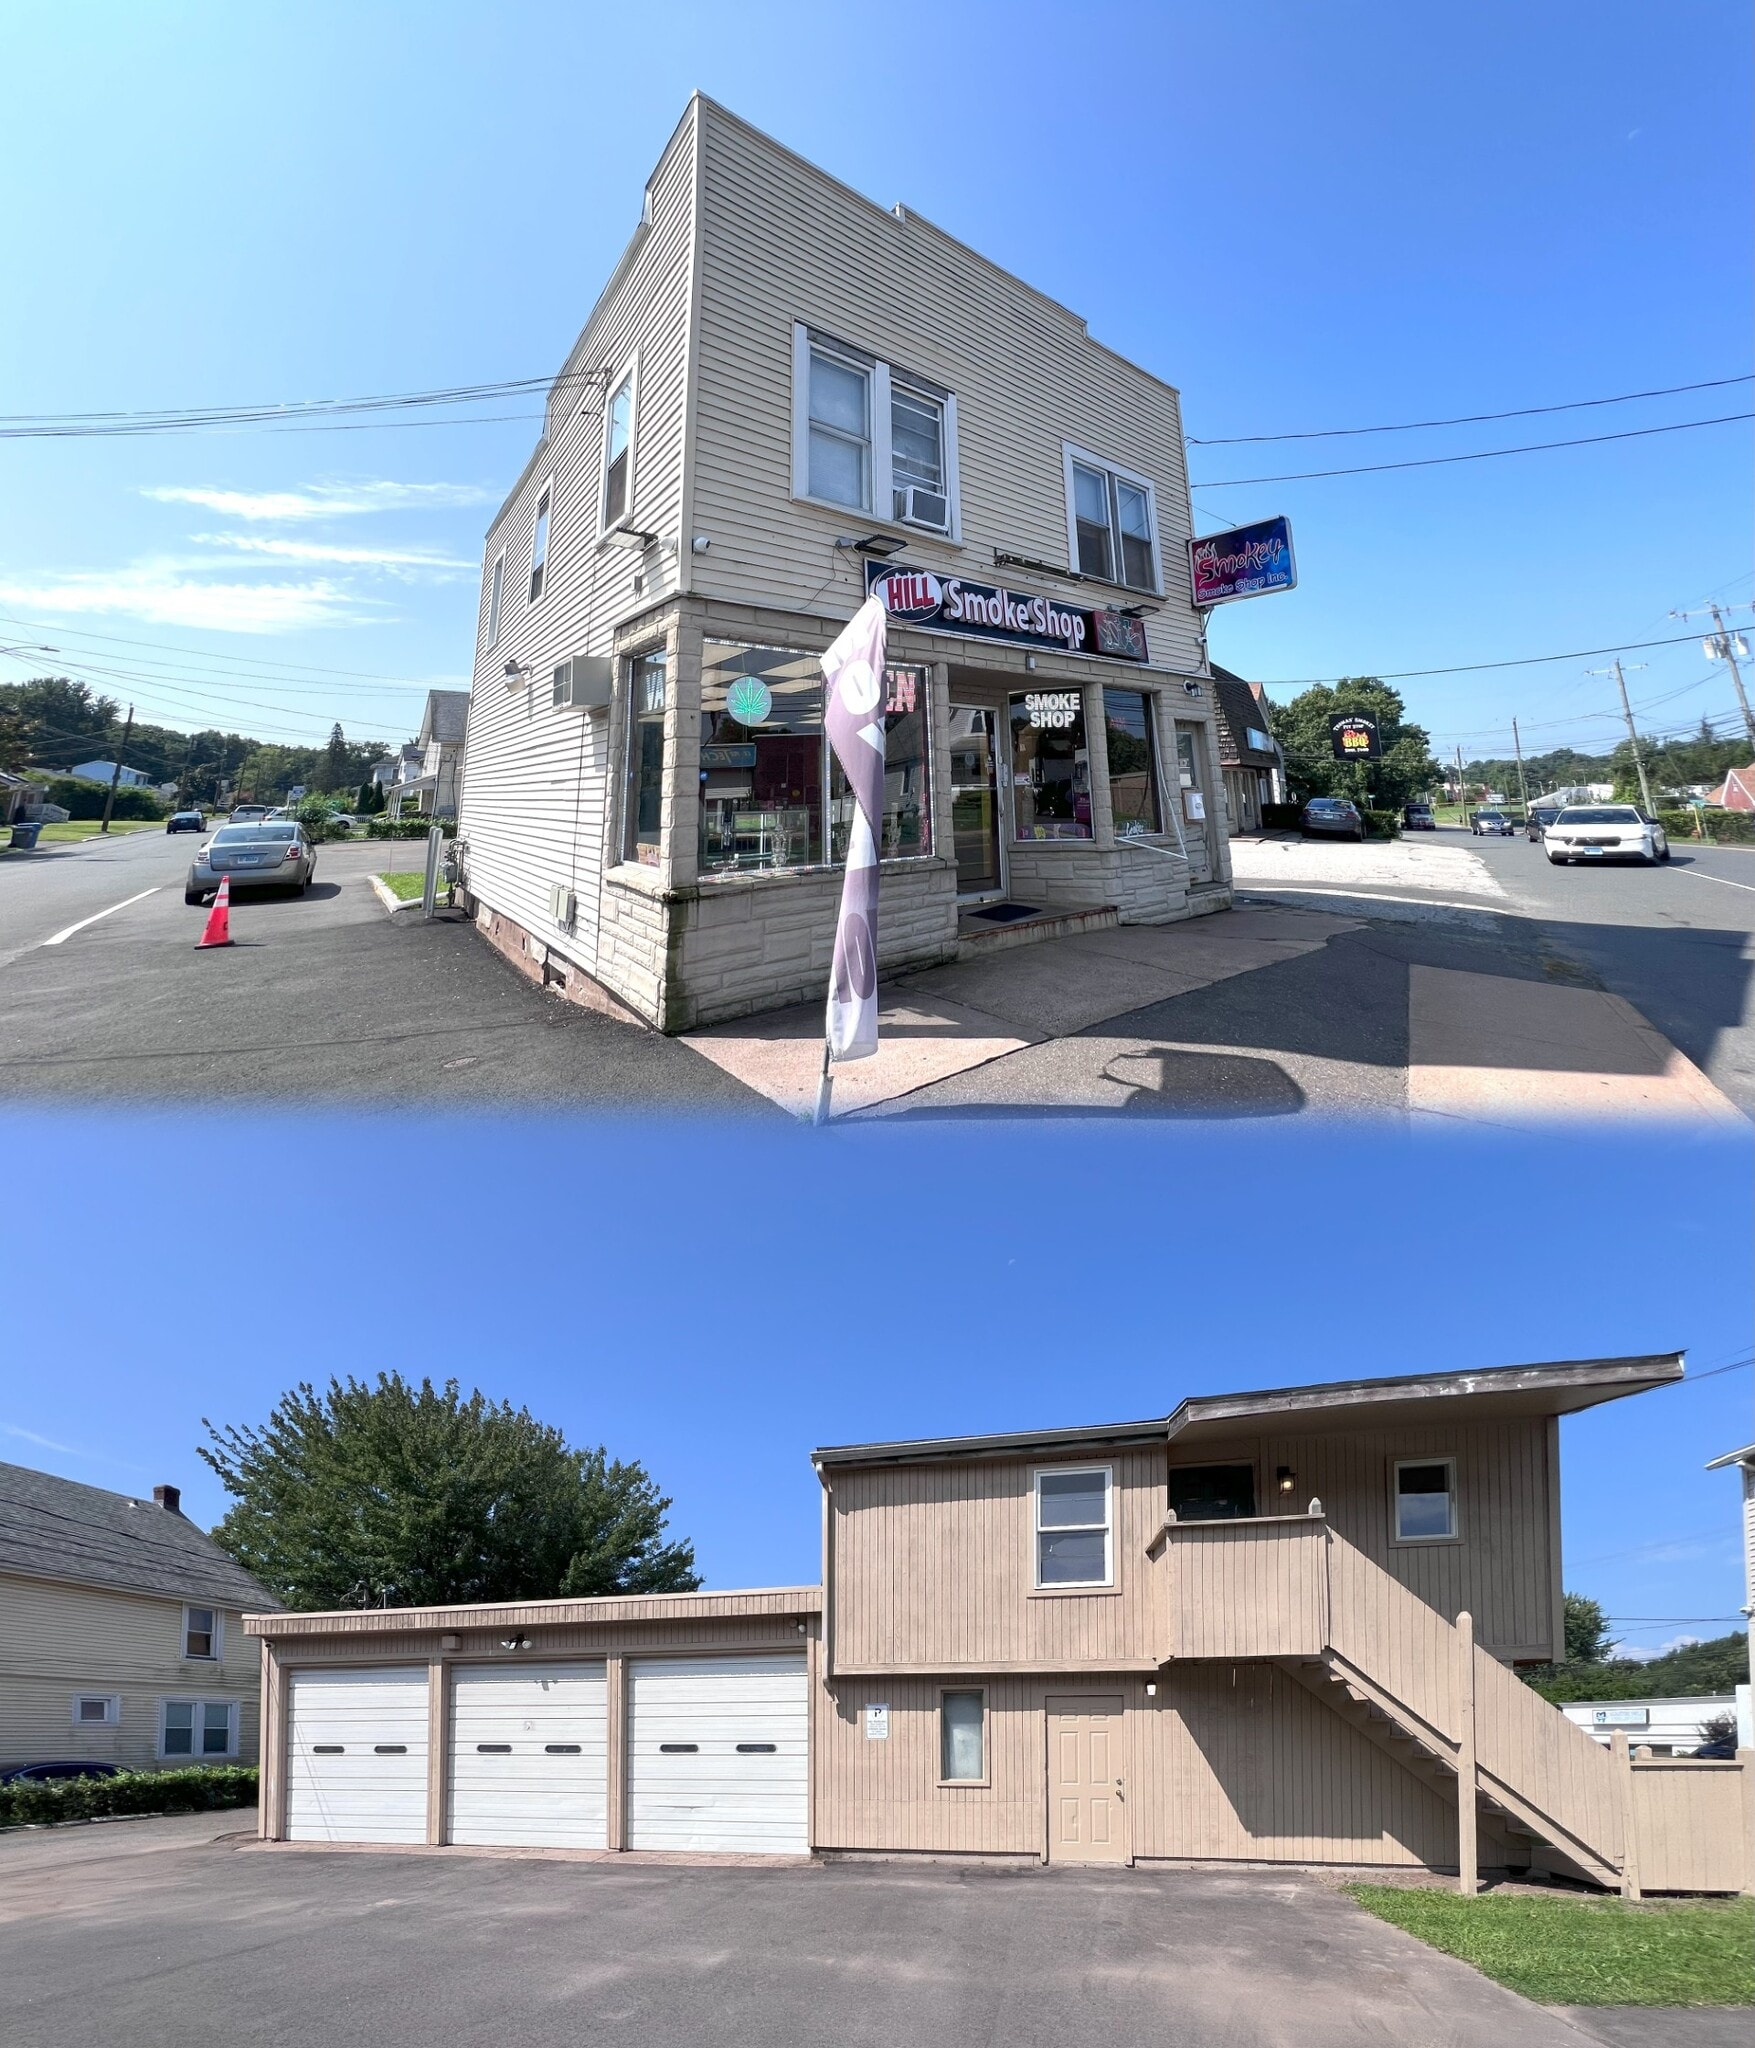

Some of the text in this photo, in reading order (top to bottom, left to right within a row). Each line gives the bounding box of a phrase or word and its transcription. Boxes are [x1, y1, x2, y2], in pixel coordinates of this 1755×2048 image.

[1195, 539, 1284, 587] Smokey
[1198, 572, 1288, 600] Smoke Shop Inc.
[886, 576, 1085, 648] HILL Smoke Shop
[1025, 693, 1080, 710] SMOKE
[1030, 711, 1075, 728] SHOP
[1345, 736, 1367, 748] BBQ
